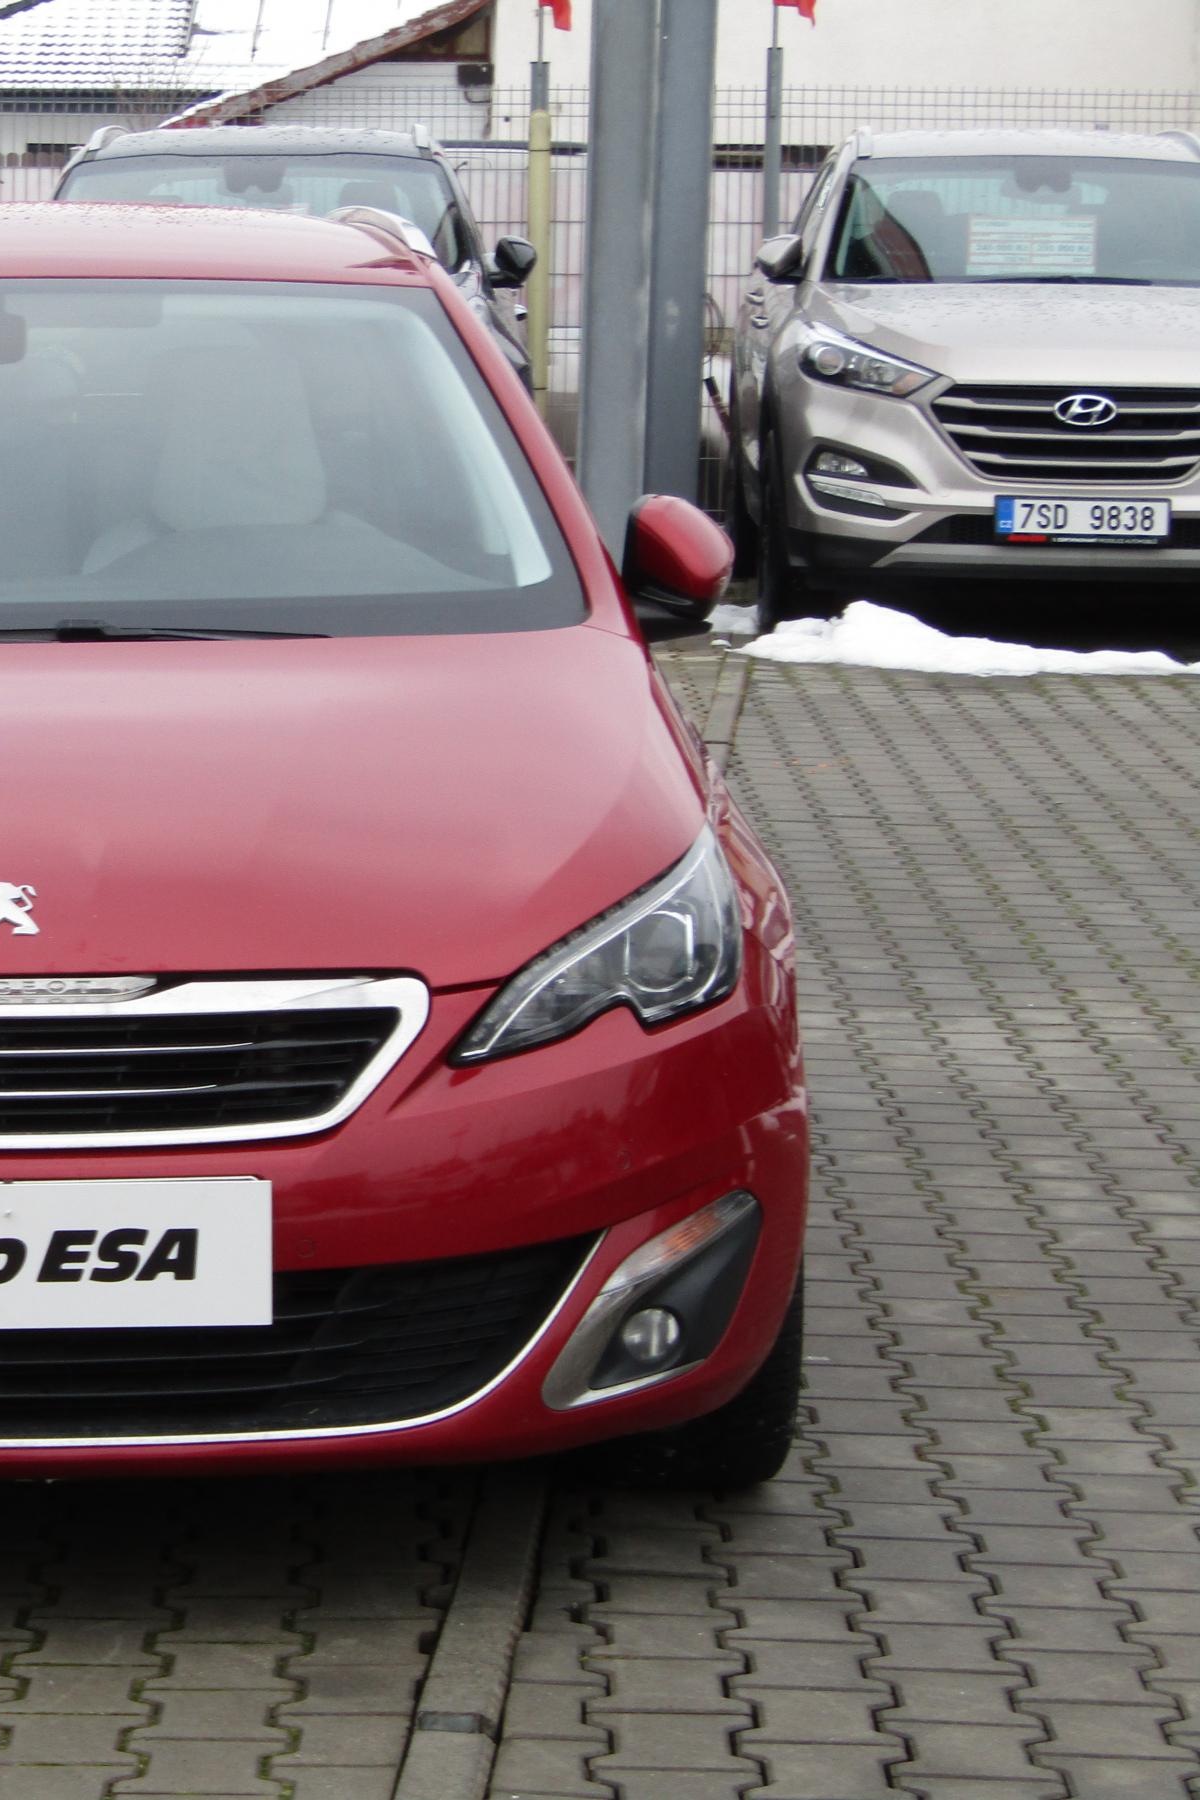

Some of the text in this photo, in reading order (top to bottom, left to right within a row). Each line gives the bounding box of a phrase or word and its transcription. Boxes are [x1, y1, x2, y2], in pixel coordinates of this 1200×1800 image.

[1020, 503, 1155, 532] 7SD 9838
[36, 1228, 199, 1283] ESA
